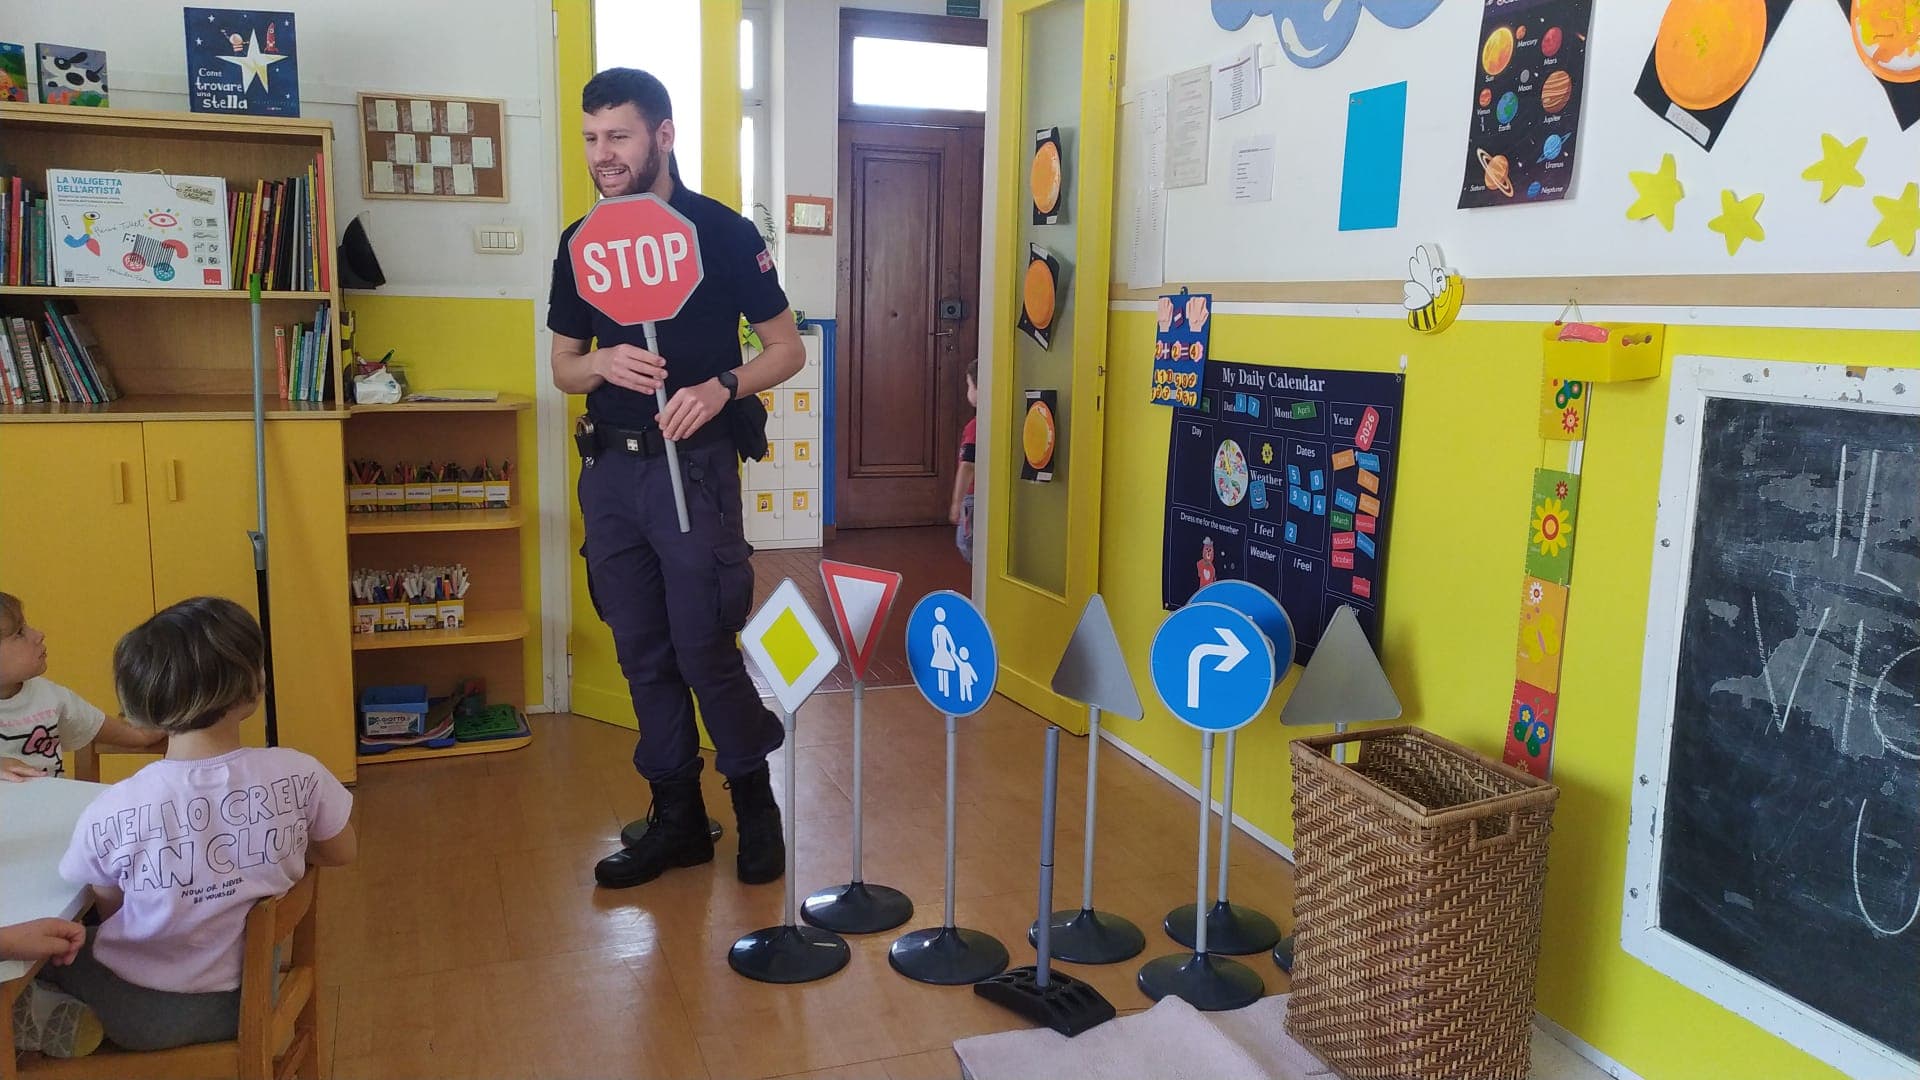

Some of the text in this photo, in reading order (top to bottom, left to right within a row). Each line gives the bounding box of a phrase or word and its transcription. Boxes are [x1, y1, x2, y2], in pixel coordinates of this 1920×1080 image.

[1517, 38, 1538, 48] Mercury
[1543, 58, 1557, 66] Mars
[199, 67, 222, 77] Come
[195, 76, 243, 92] trovare
[1517, 84, 1533, 93] Moon
[202, 95, 248, 109] stella
[1543, 115, 1561, 125] Jupiter
[1498, 123, 1512, 132] Earth
[1545, 161, 1564, 169] Uranus
[56, 176, 122, 186] LA VALIGETTA
[1470, 183, 1485, 192] Saturn
[57, 185, 121, 195] DELL'ARTISTA
[1541, 185, 1563, 195] Neptune
[583, 232, 688, 293] STOP
[1222, 367, 1326, 392] My Daily Calendar
[1223, 400, 1236, 412] Dat
[1274, 406, 1293, 419] Mont
[1297, 405, 1311, 416] April
[1333, 412, 1354, 427] Year
[1191, 425, 1203, 438] Day
[1359, 412, 1376, 445] 2026
[1296, 444, 1316, 458] Dates
[1250, 469, 1283, 487] Weather
[1339, 494, 1353, 509] Friday
[1180, 511, 1195, 523] Dress
[1210, 519, 1218, 530] the
[1333, 515, 1349, 525] March
[1833, 444, 1903, 594] IL
[1259, 523, 1274, 538] feel
[1334, 537, 1353, 545] Monday
[1250, 545, 1277, 562] Weather
[1333, 553, 1352, 564] October
[1297, 558, 1312, 573] Feel
[92, 772, 319, 859] HELLO CREW
[112, 817, 312, 892] FAN CLUB
[181, 877, 244, 899] NOW OR NEVER
[193, 887, 236, 905] BE YOURSELF
